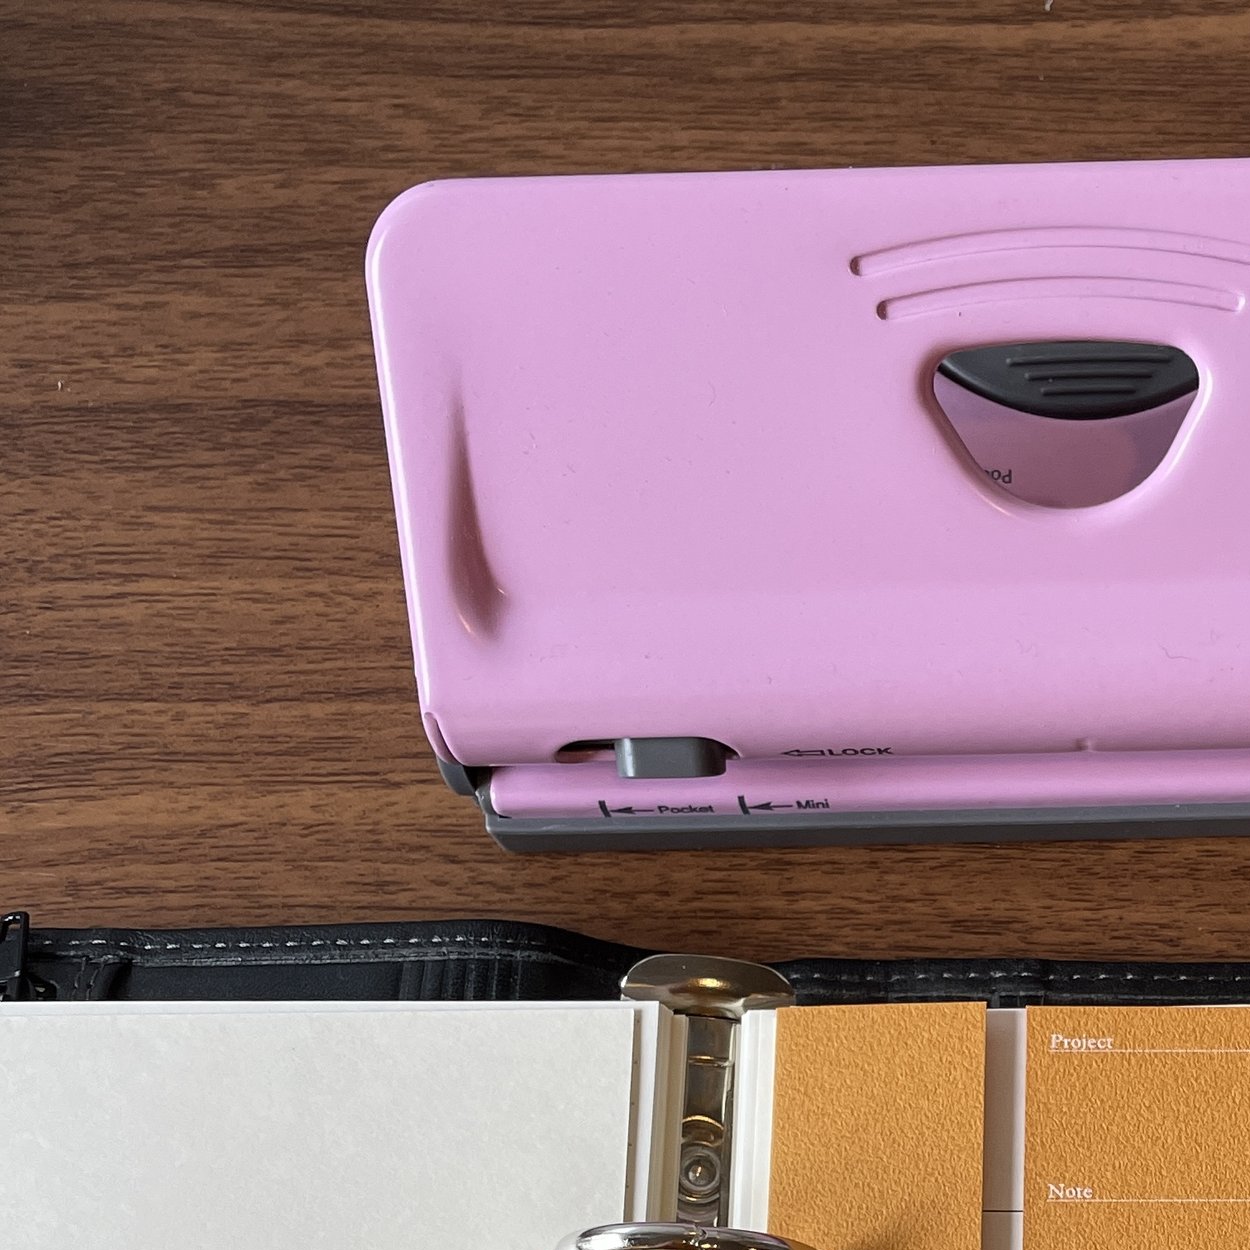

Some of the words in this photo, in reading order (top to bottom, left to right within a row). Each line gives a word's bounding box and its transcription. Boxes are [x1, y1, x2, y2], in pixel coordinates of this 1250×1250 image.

[828, 747, 894, 757] LOCK
[657, 804, 716, 814] Pocket
[796, 798, 831, 810] Mini
[1050, 1034, 1114, 1050] Project
[1047, 1183, 1094, 1199] Note
